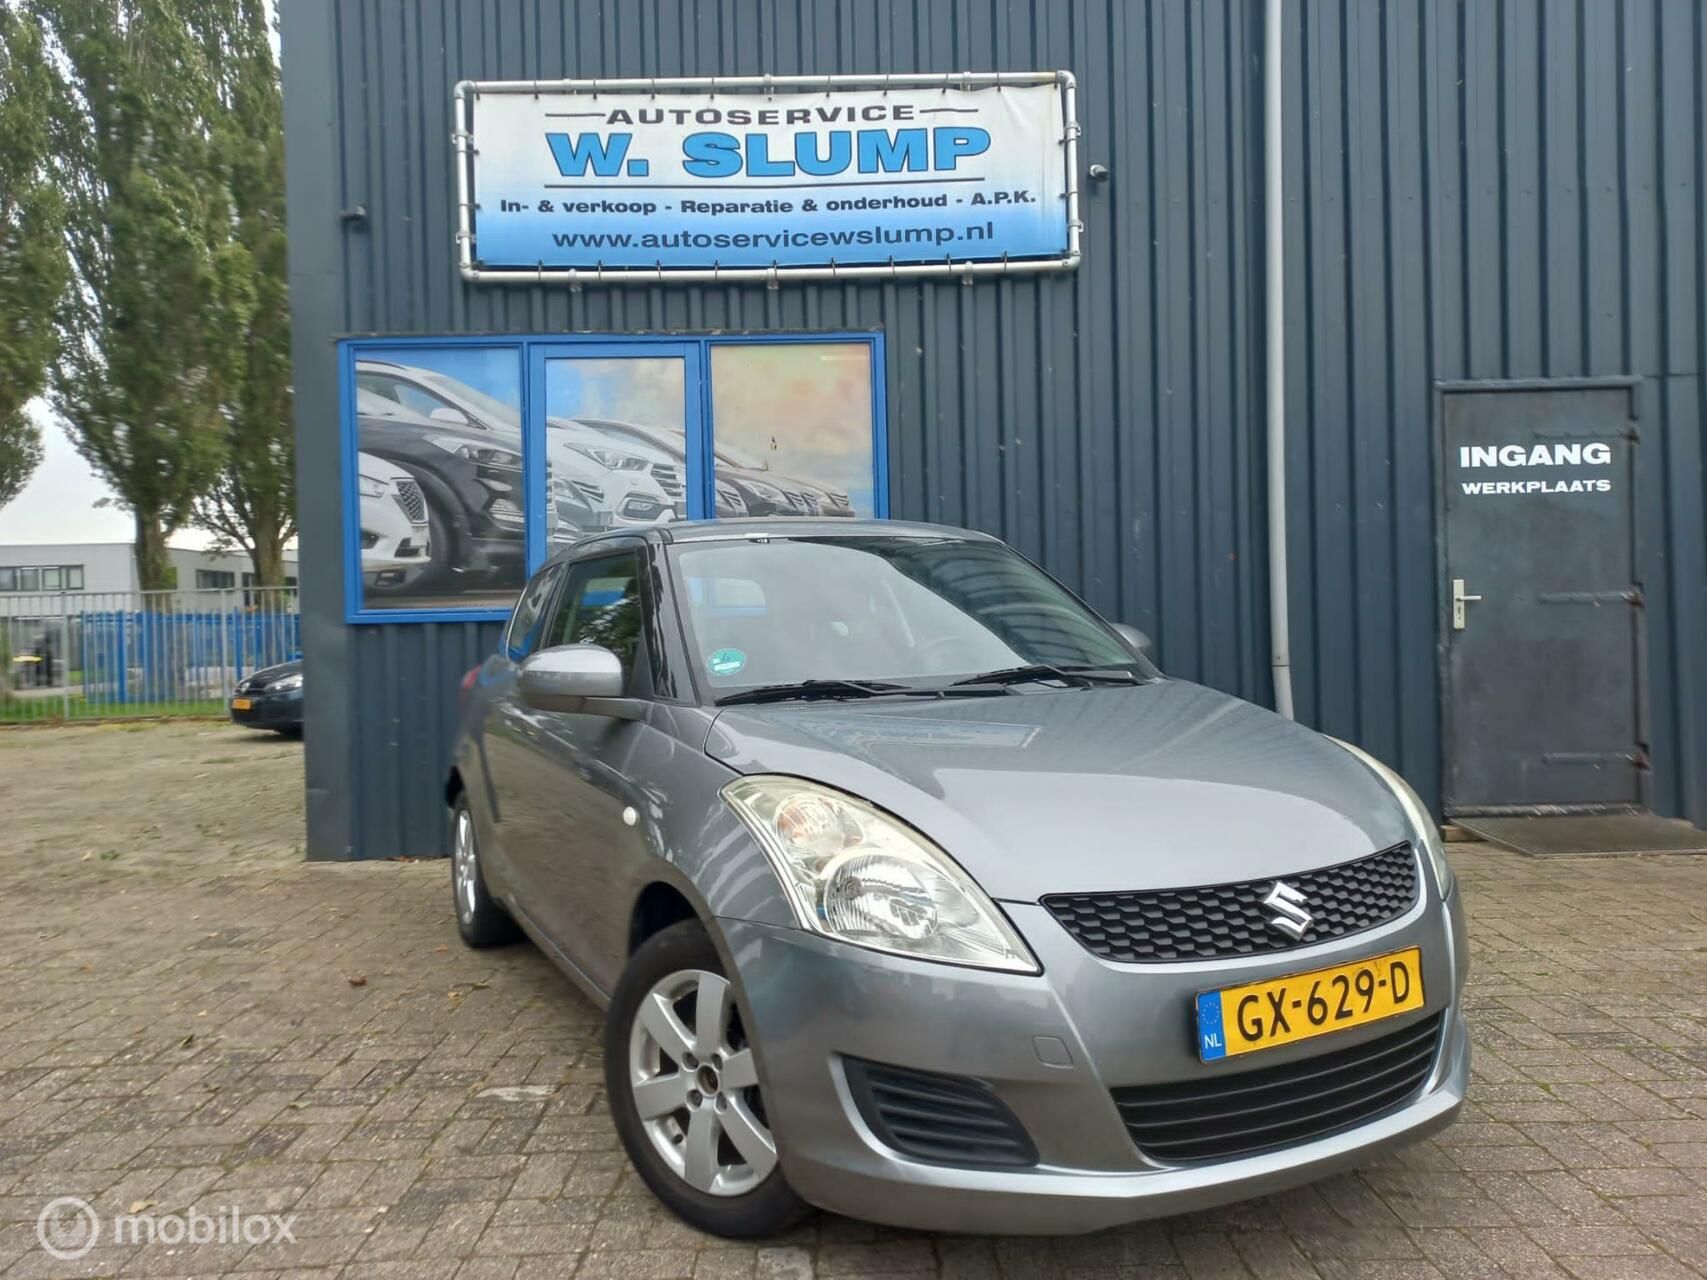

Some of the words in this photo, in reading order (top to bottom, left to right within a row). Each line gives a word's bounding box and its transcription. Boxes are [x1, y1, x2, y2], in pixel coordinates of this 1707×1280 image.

[606, 105, 914, 126] AUTOSERVICE
[545, 133, 649, 177] W.
[682, 127, 991, 178] SLUMP
[500, 199, 529, 213] In-
[537, 200, 555, 213] &
[562, 199, 657, 216] verkoop
[680, 198, 793, 216] Reparatie
[801, 199, 818, 213] &
[826, 194, 947, 211] onderhoud
[971, 190, 1036, 206] A.P.K.
[552, 221, 993, 249] www.autoservicewslump.nl
[1460, 443, 1611, 468] INGANG
[1461, 479, 1612, 495] WERKPLAATS
[1237, 961, 1409, 1042] GX-629-D
[1203, 1033, 1223, 1050] NL
